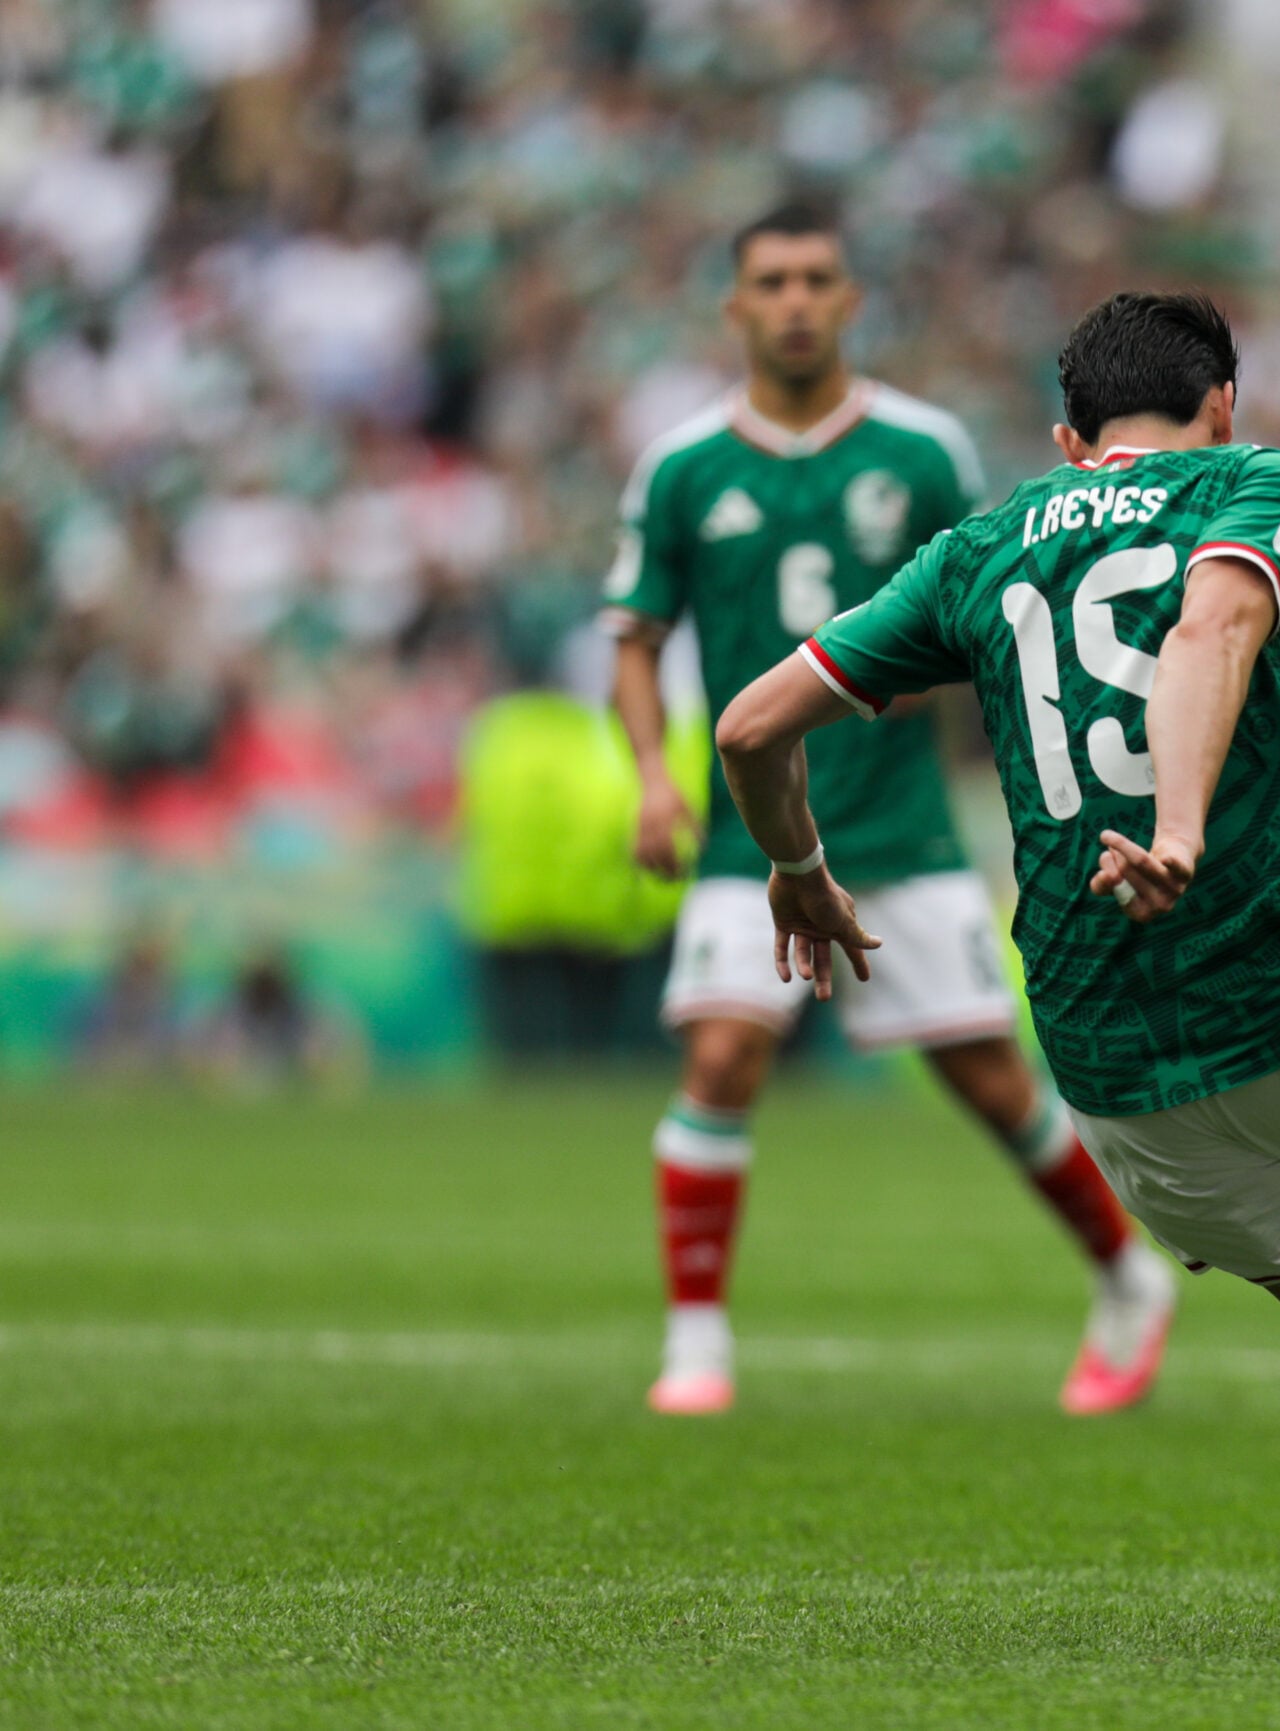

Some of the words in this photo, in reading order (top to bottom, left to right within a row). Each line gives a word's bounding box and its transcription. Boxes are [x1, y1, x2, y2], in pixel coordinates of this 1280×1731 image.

[1022, 485, 1168, 548] I.REYES
[777, 543, 837, 637] 6
[1001, 543, 1178, 821] 15
